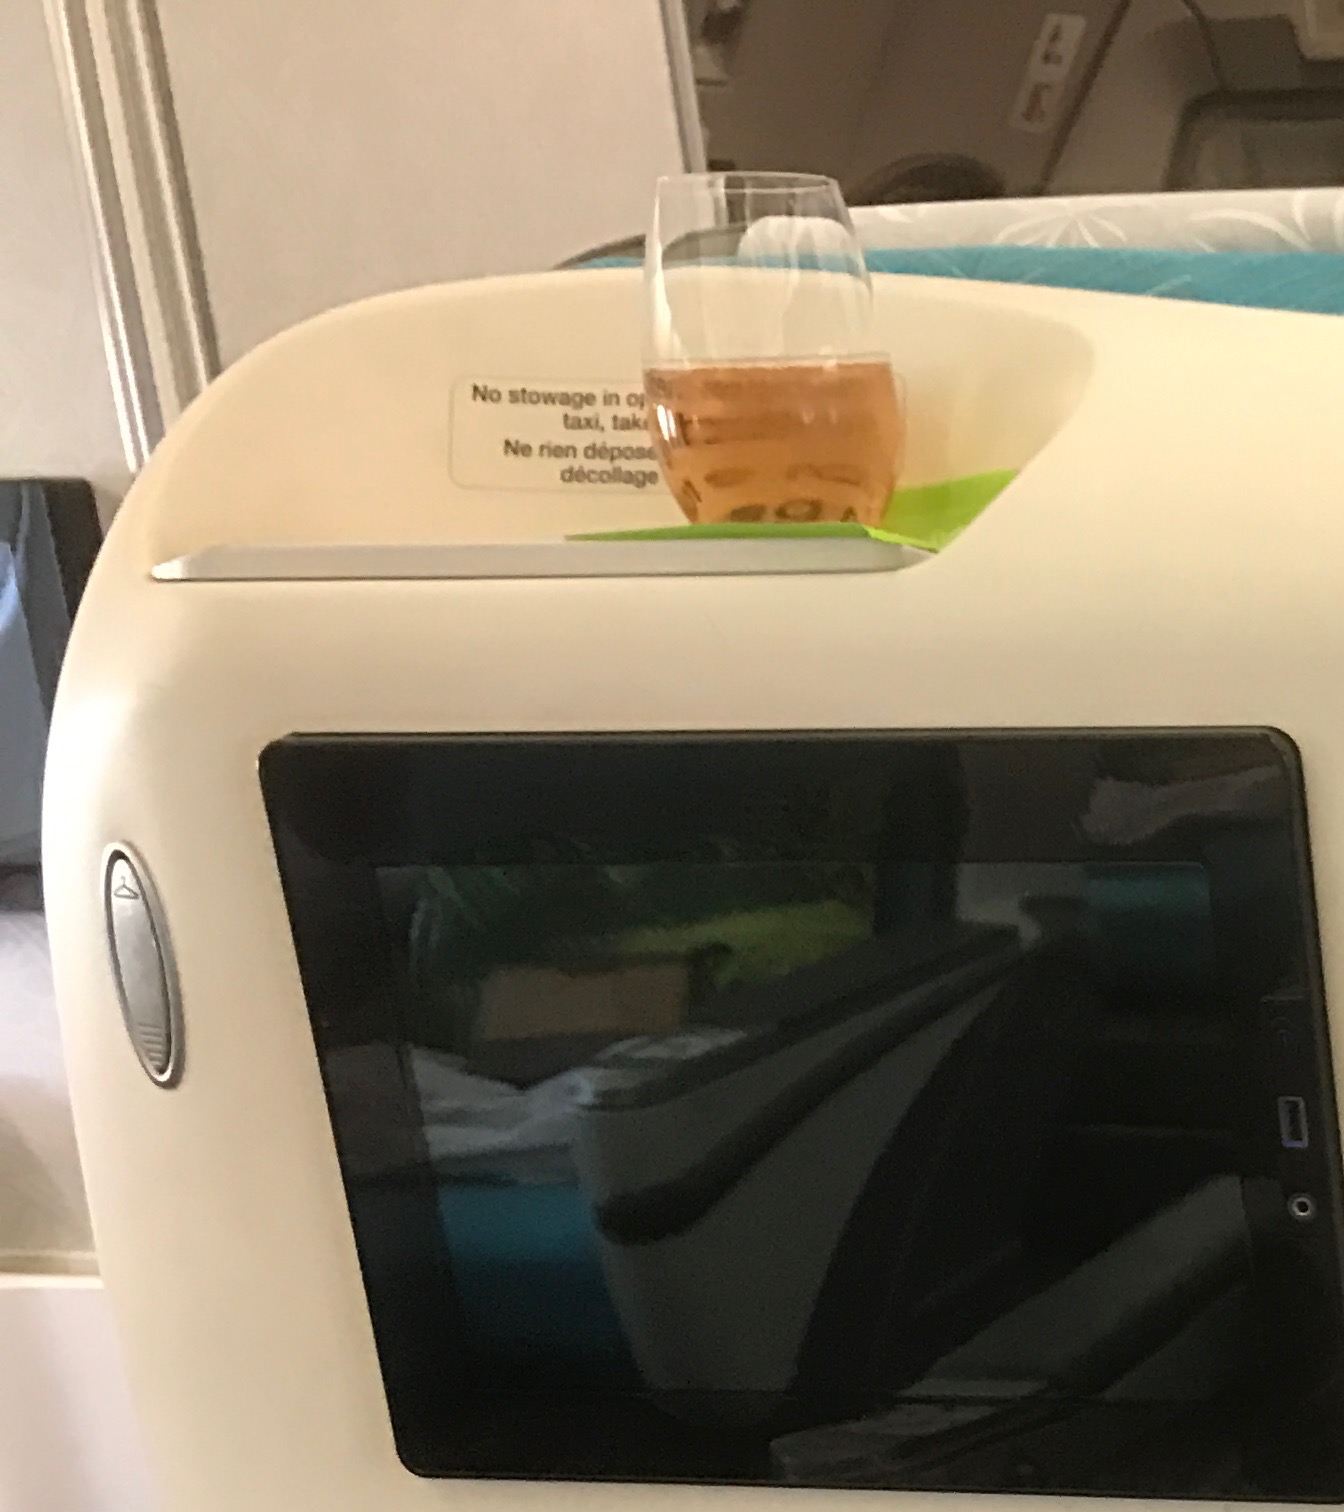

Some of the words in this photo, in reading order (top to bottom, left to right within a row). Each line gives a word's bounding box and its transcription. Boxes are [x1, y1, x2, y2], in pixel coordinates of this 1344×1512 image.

[472, 384, 501, 403] No
[509, 388, 596, 410] stowage
[603, 391, 620, 406] in
[626, 393, 645, 410] op
[563, 413, 604, 432] taxi,
[504, 439, 532, 457] Ne
[539, 442, 577, 459] rien
[582, 441, 658, 464] dépose
[560, 466, 658, 489] décollage
